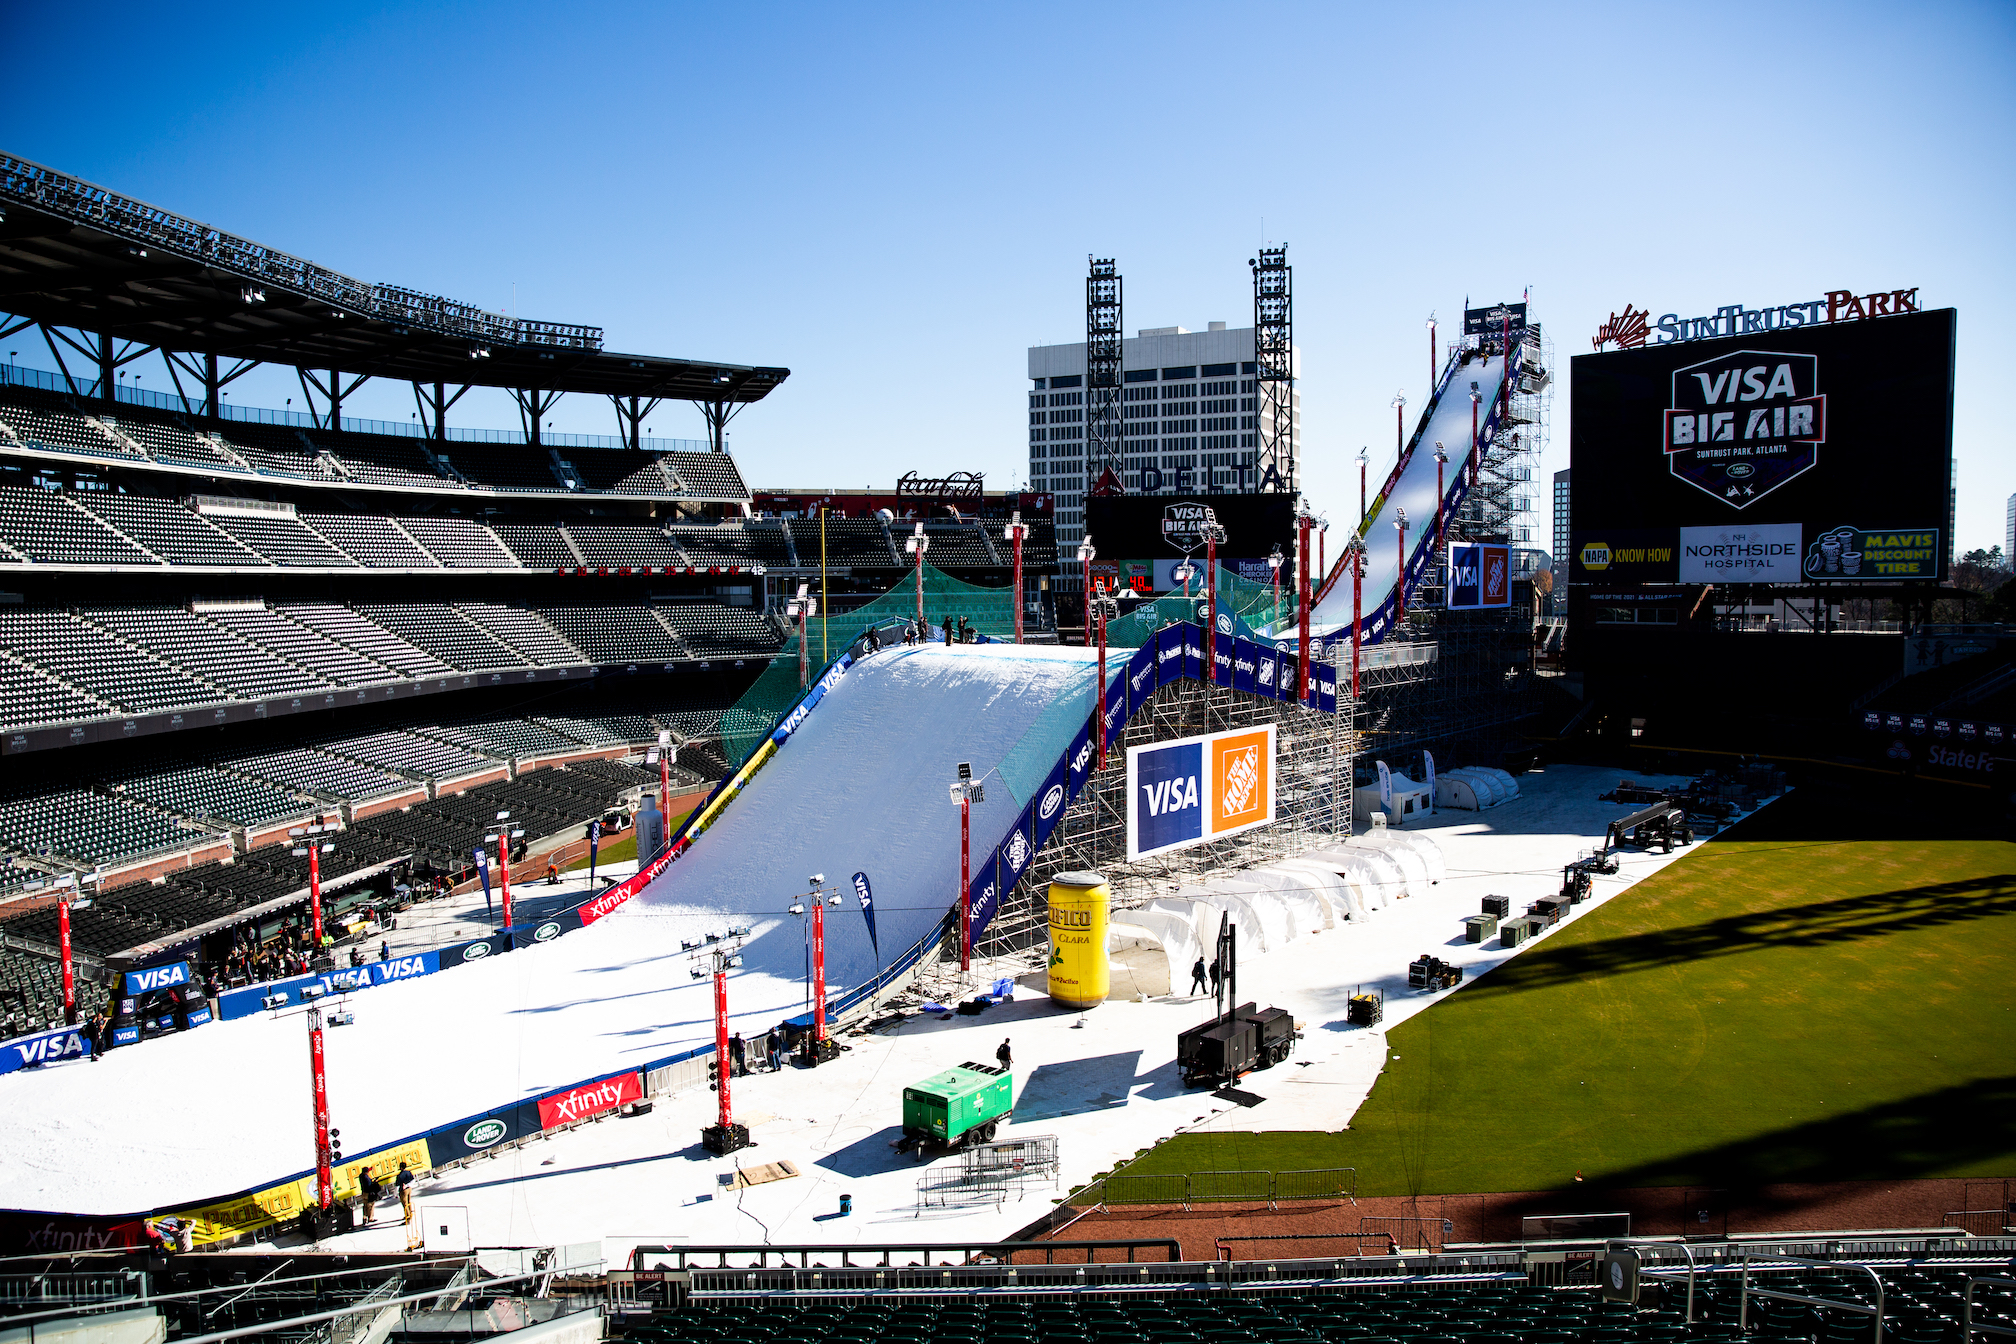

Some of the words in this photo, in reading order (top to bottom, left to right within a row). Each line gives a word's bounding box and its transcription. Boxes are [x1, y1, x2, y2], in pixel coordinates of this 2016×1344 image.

[1691, 363, 1796, 404] VISA
[1673, 412, 1734, 444] BIG
[1744, 405, 1813, 440] AIR
[1696, 449, 1731, 458] SUNTRUST
[1756, 445, 1787, 455] ATLANTA
[900, 470, 987, 498] Coca-Cola
[1141, 464, 1286, 494] DELTA
[1171, 508, 1203, 519] VISA
[1165, 521, 1185, 532] BIG
[1685, 543, 1796, 557] NORTHSIDE
[1866, 535, 1933, 547] MAVIS
[1584, 552, 1608, 563] NAPA
[1615, 549, 1645, 562] KNOW
[1647, 548, 1671, 561] HOW
[1705, 559, 1774, 568] HOSPITAL
[1865, 549, 1931, 561] DISCOUNT
[708, 566, 721, 576] 44
[728, 566, 740, 576] 47
[751, 565, 764, 576] 42
[1454, 566, 1477, 586] VISA
[1875, 562, 1919, 574] TIRE
[1360, 629, 1370, 642] ISA
[1372, 617, 1384, 634] VISA
[1214, 651, 1232, 668] finity
[1235, 658, 1255, 674] xfinity
[819, 662, 846, 692] VISA
[1320, 680, 1336, 696] VISA
[780, 705, 808, 732] VISA
[1070, 738, 1096, 773] VISA
[1224, 746, 1258, 815] HOME
[1226, 756, 1242, 782] THE
[1142, 776, 1198, 817] VISA
[1236, 769, 1258, 812] DEPOT
[592, 822, 600, 846] VISA
[647, 845, 683, 881] xfinity
[1012, 834, 1022, 868] HOME
[589, 885, 633, 919] xfinity
[854, 873, 871, 909] VISA
[970, 881, 995, 923] xfinity
[1058, 934, 1090, 944] CLARA
[132, 966, 184, 990] VISA
[376, 957, 424, 979] VISA
[190, 1012, 210, 1023] VISA
[116, 1031, 136, 1040] VISA
[14, 1033, 83, 1063] VISA
[556, 1082, 622, 1119] xfinity
[472, 1124, 492, 1137] LAND
[476, 1130, 500, 1142] ROVER
[370, 1142, 421, 1162] CERVEZA
[346, 1148, 423, 1189] PCIFICO
[202, 1192, 294, 1235] PACIFICO
[24, 1222, 114, 1251] xfinity
